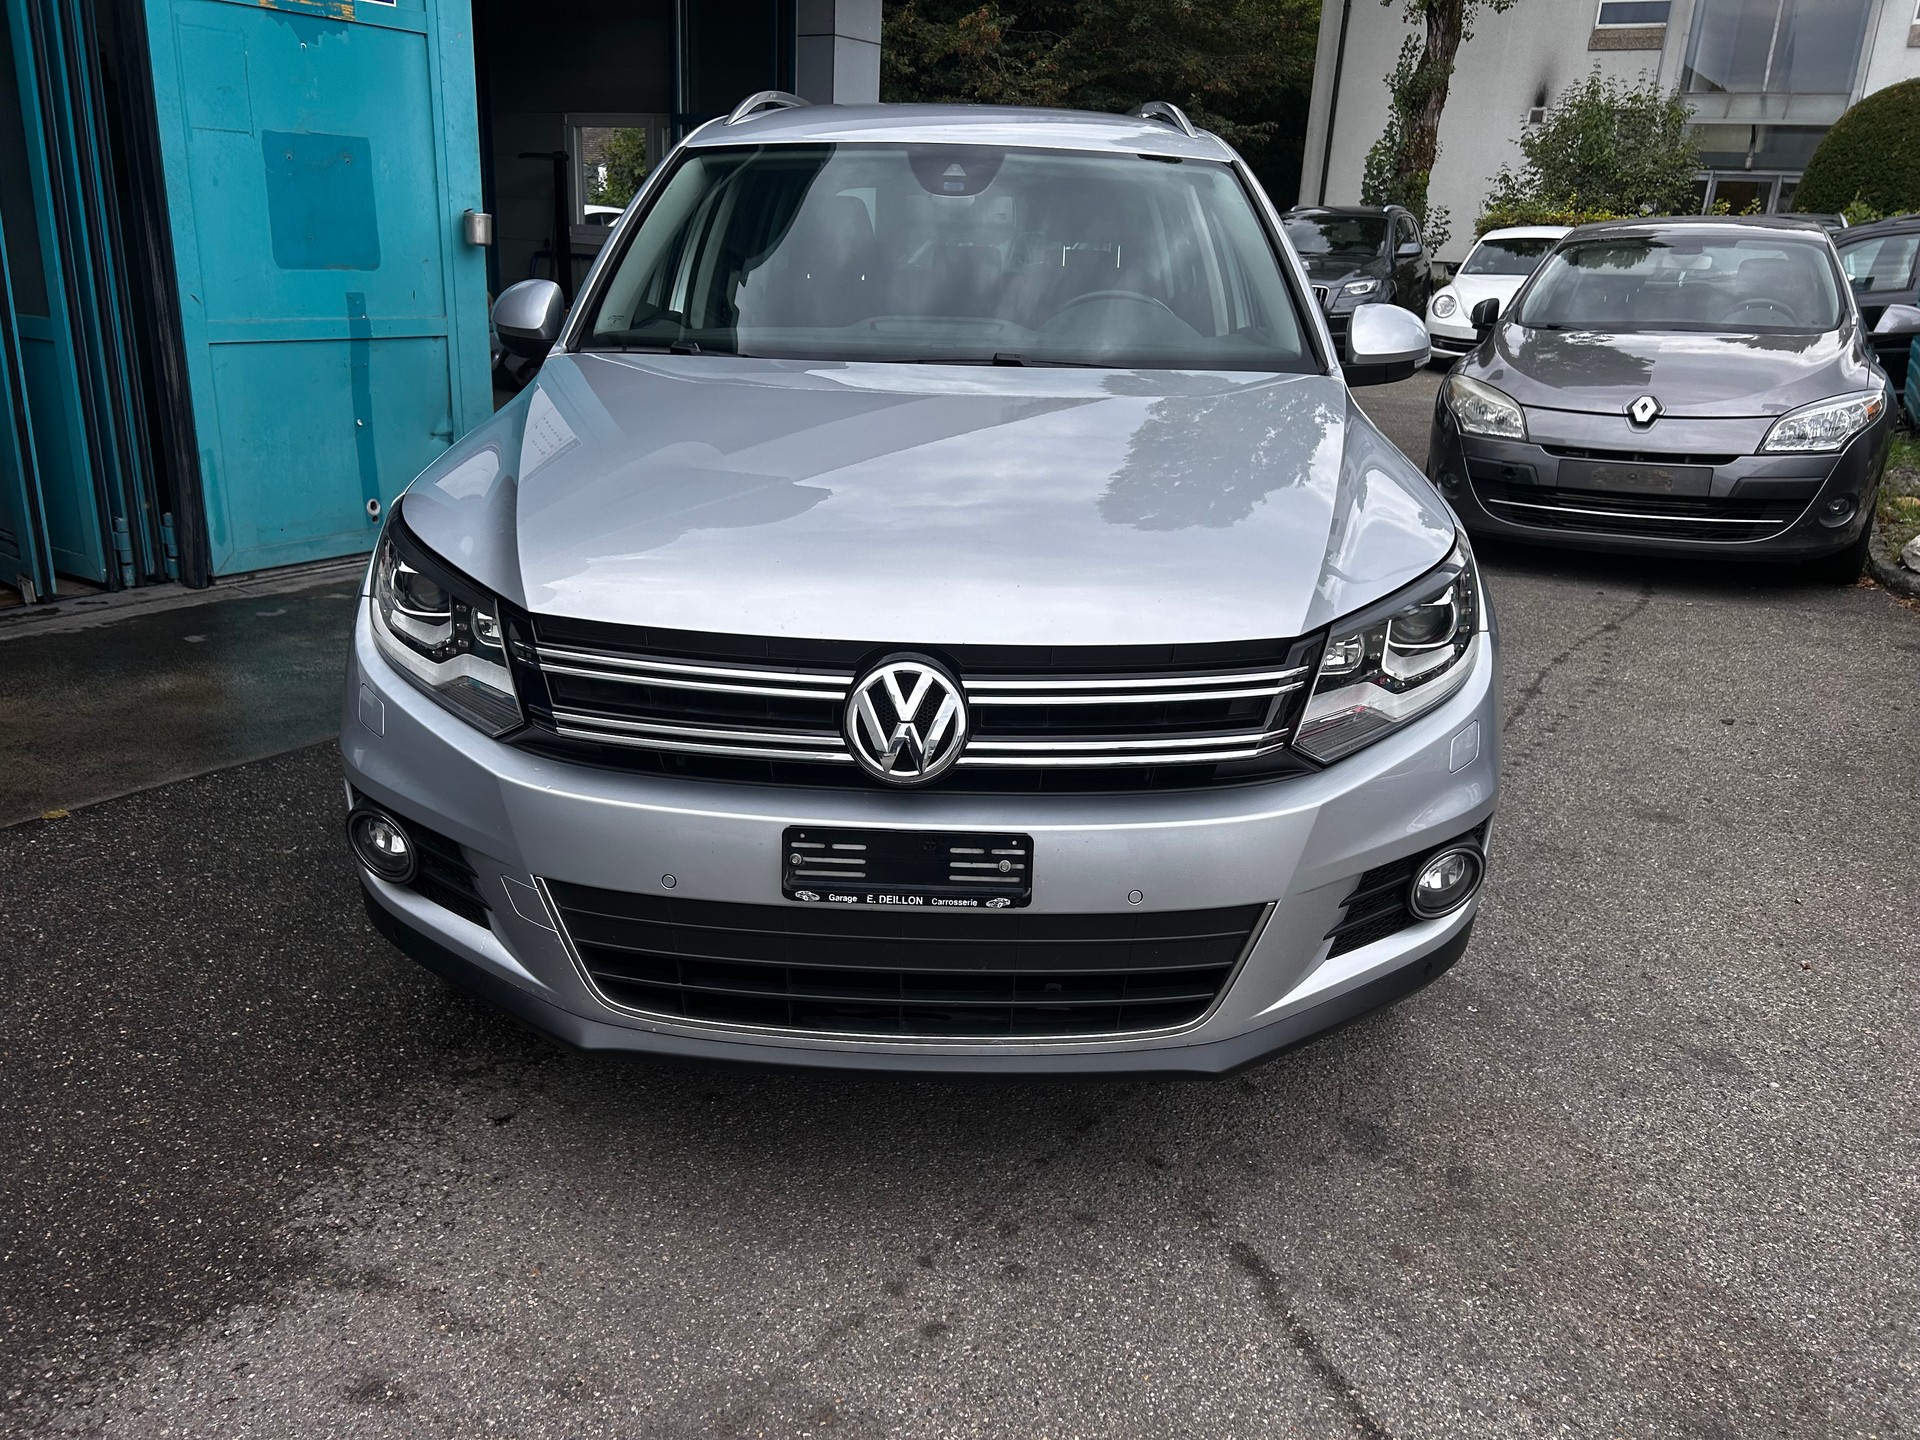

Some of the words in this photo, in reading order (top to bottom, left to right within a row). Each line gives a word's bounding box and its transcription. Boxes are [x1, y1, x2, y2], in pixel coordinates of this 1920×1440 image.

[847, 662, 966, 783] VW
[828, 893, 858, 904] Garage
[866, 894, 877, 905] E.
[878, 894, 924, 906] DEILLON
[931, 897, 978, 907] Carrosserie
